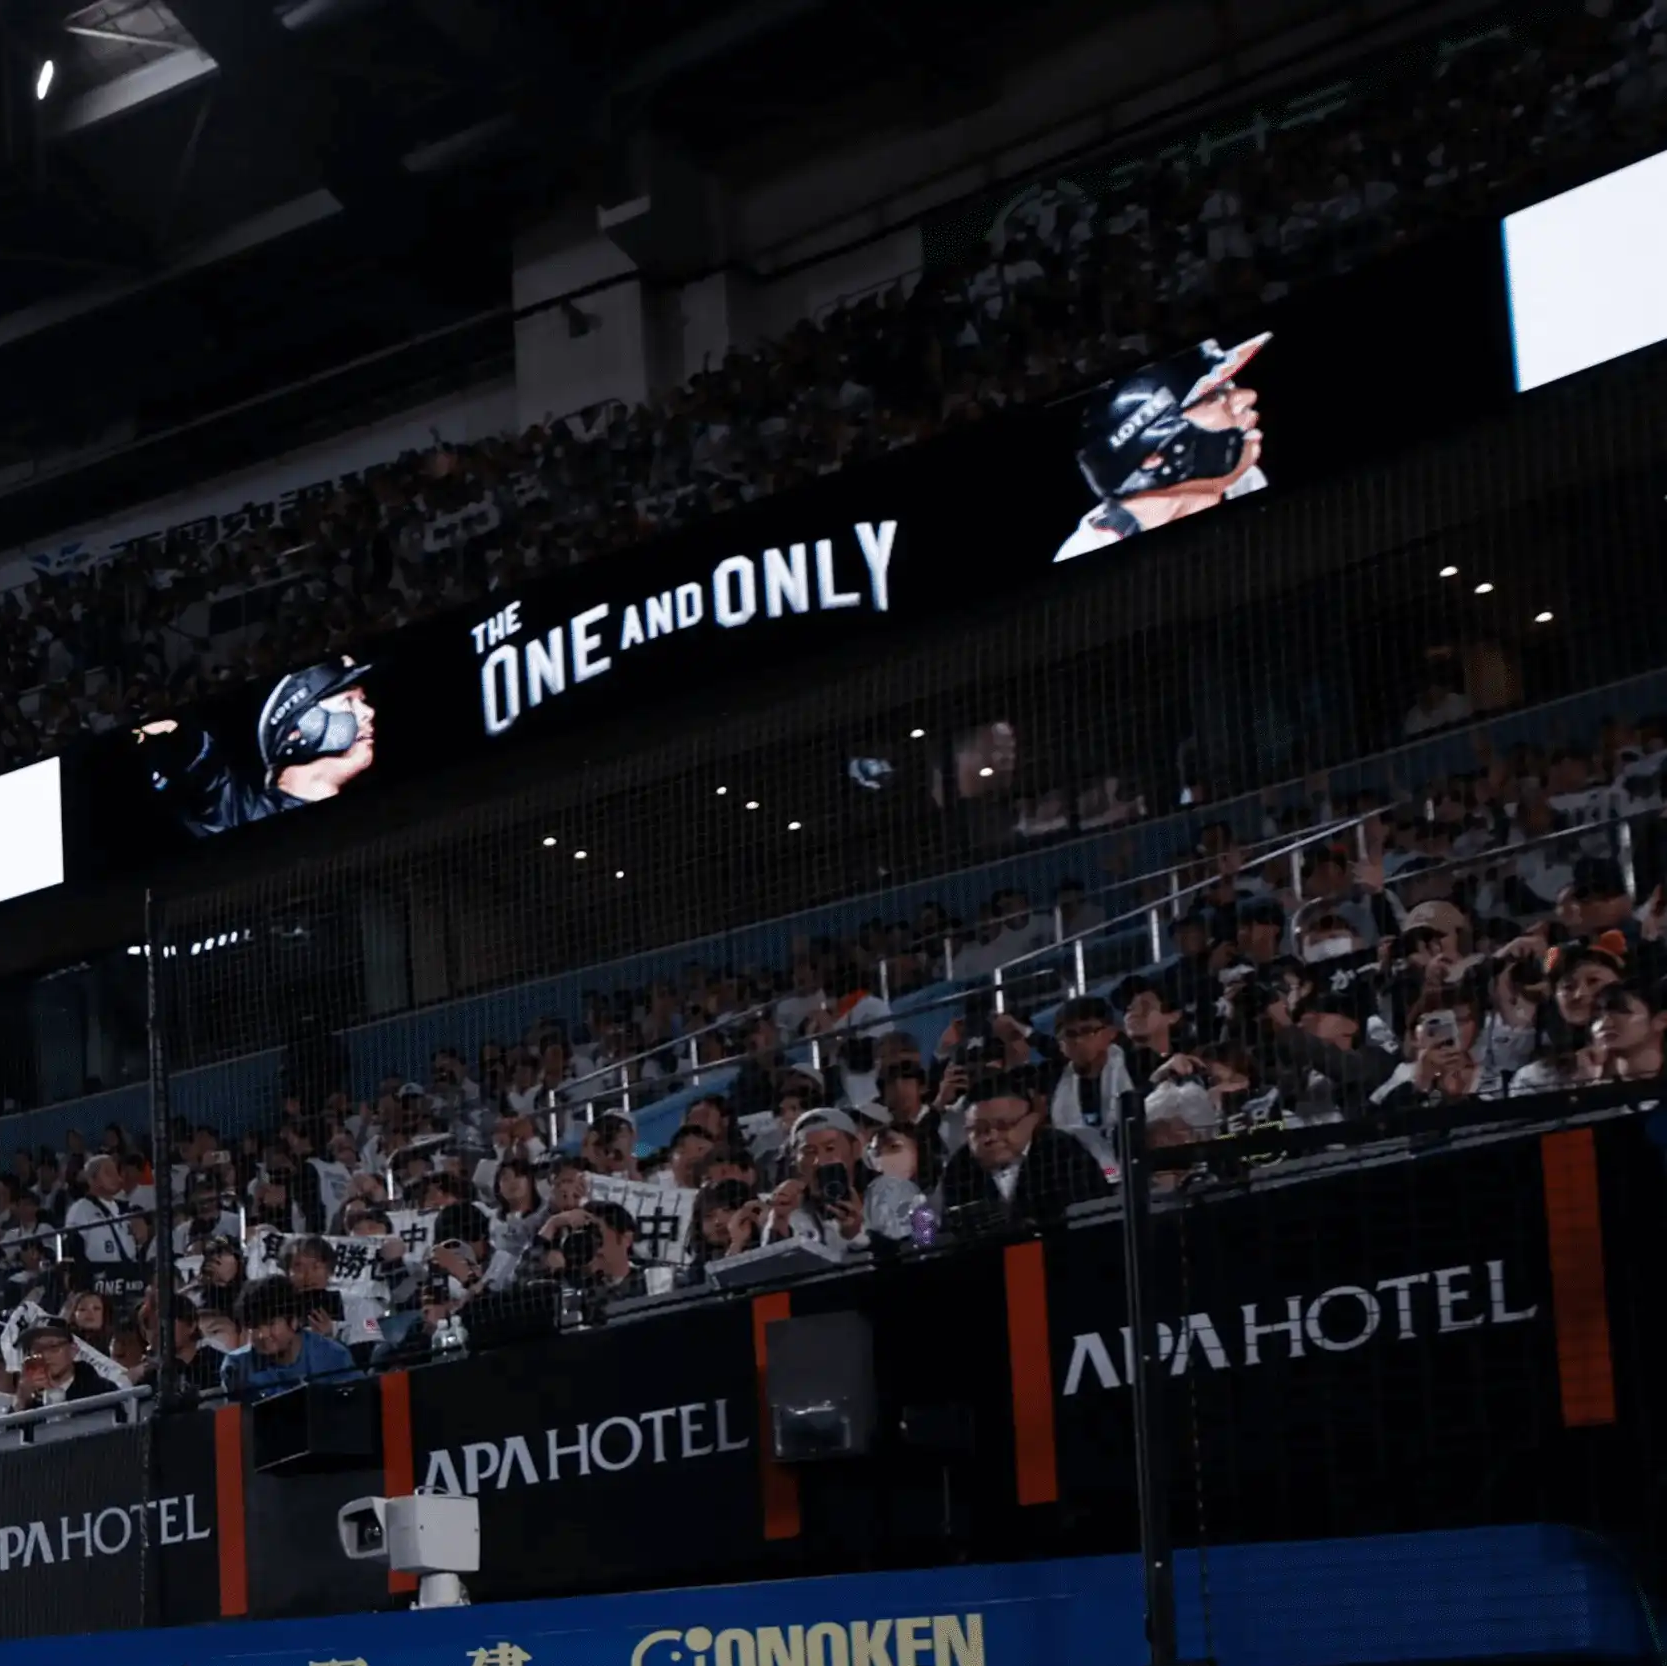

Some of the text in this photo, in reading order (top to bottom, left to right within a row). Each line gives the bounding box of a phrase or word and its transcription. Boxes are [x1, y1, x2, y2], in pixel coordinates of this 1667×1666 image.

[470, 601, 522, 655] THE
[480, 519, 899, 736] ONE AND ONLY
[635, 1206, 680, 1257] 中
[1240, 1259, 1539, 1367] HOTEL
[423, 1398, 750, 1497] APA HOTEL
[62, 1493, 211, 1562] HOTEL
